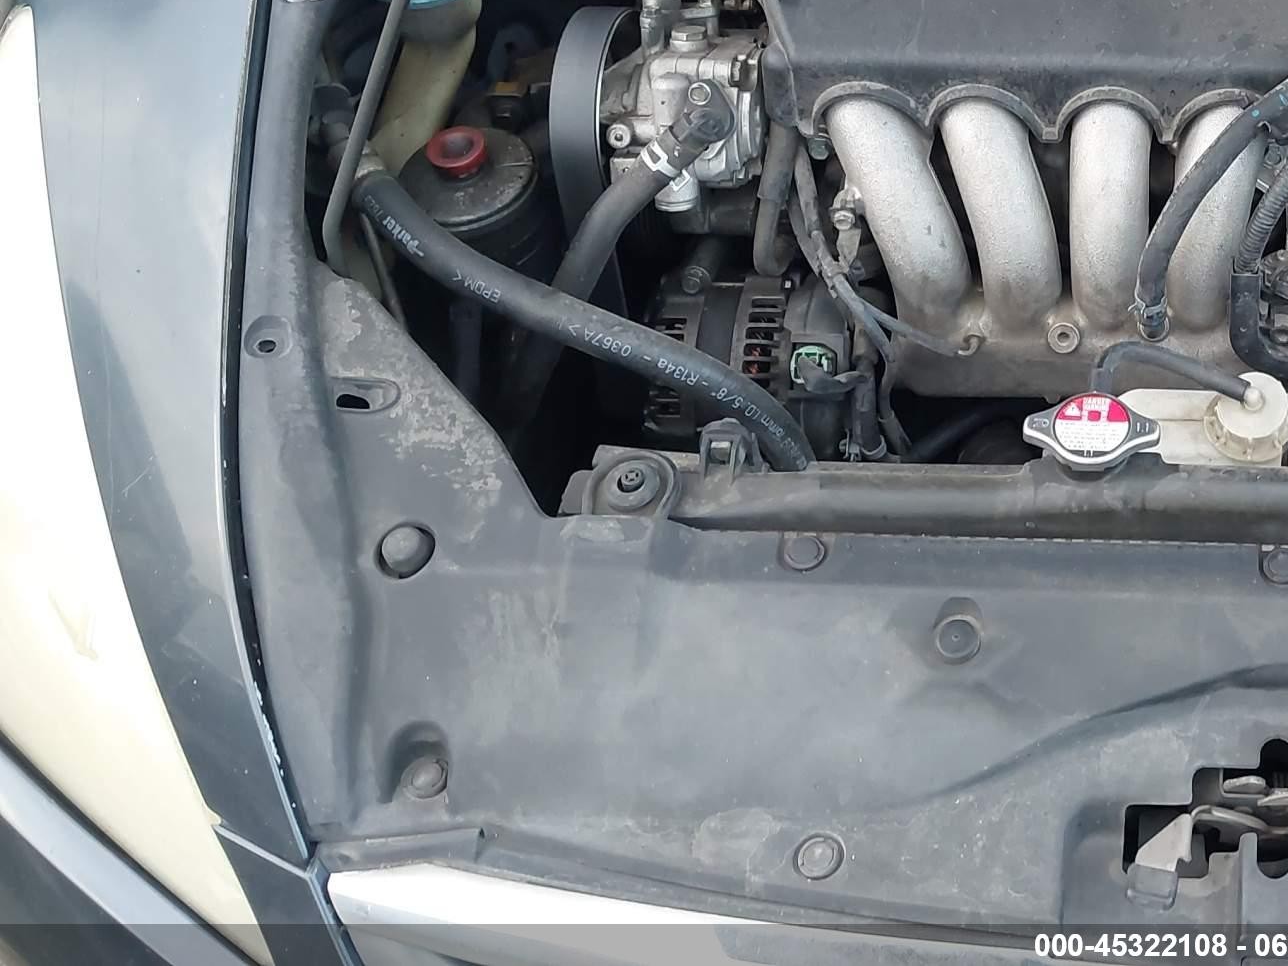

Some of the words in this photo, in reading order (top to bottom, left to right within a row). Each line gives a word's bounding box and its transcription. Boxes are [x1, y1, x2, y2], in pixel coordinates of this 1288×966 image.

[382, 215, 424, 257] Parker
[583, 327, 632, 357] 0367A
[656, 357, 700, 386] R134a
